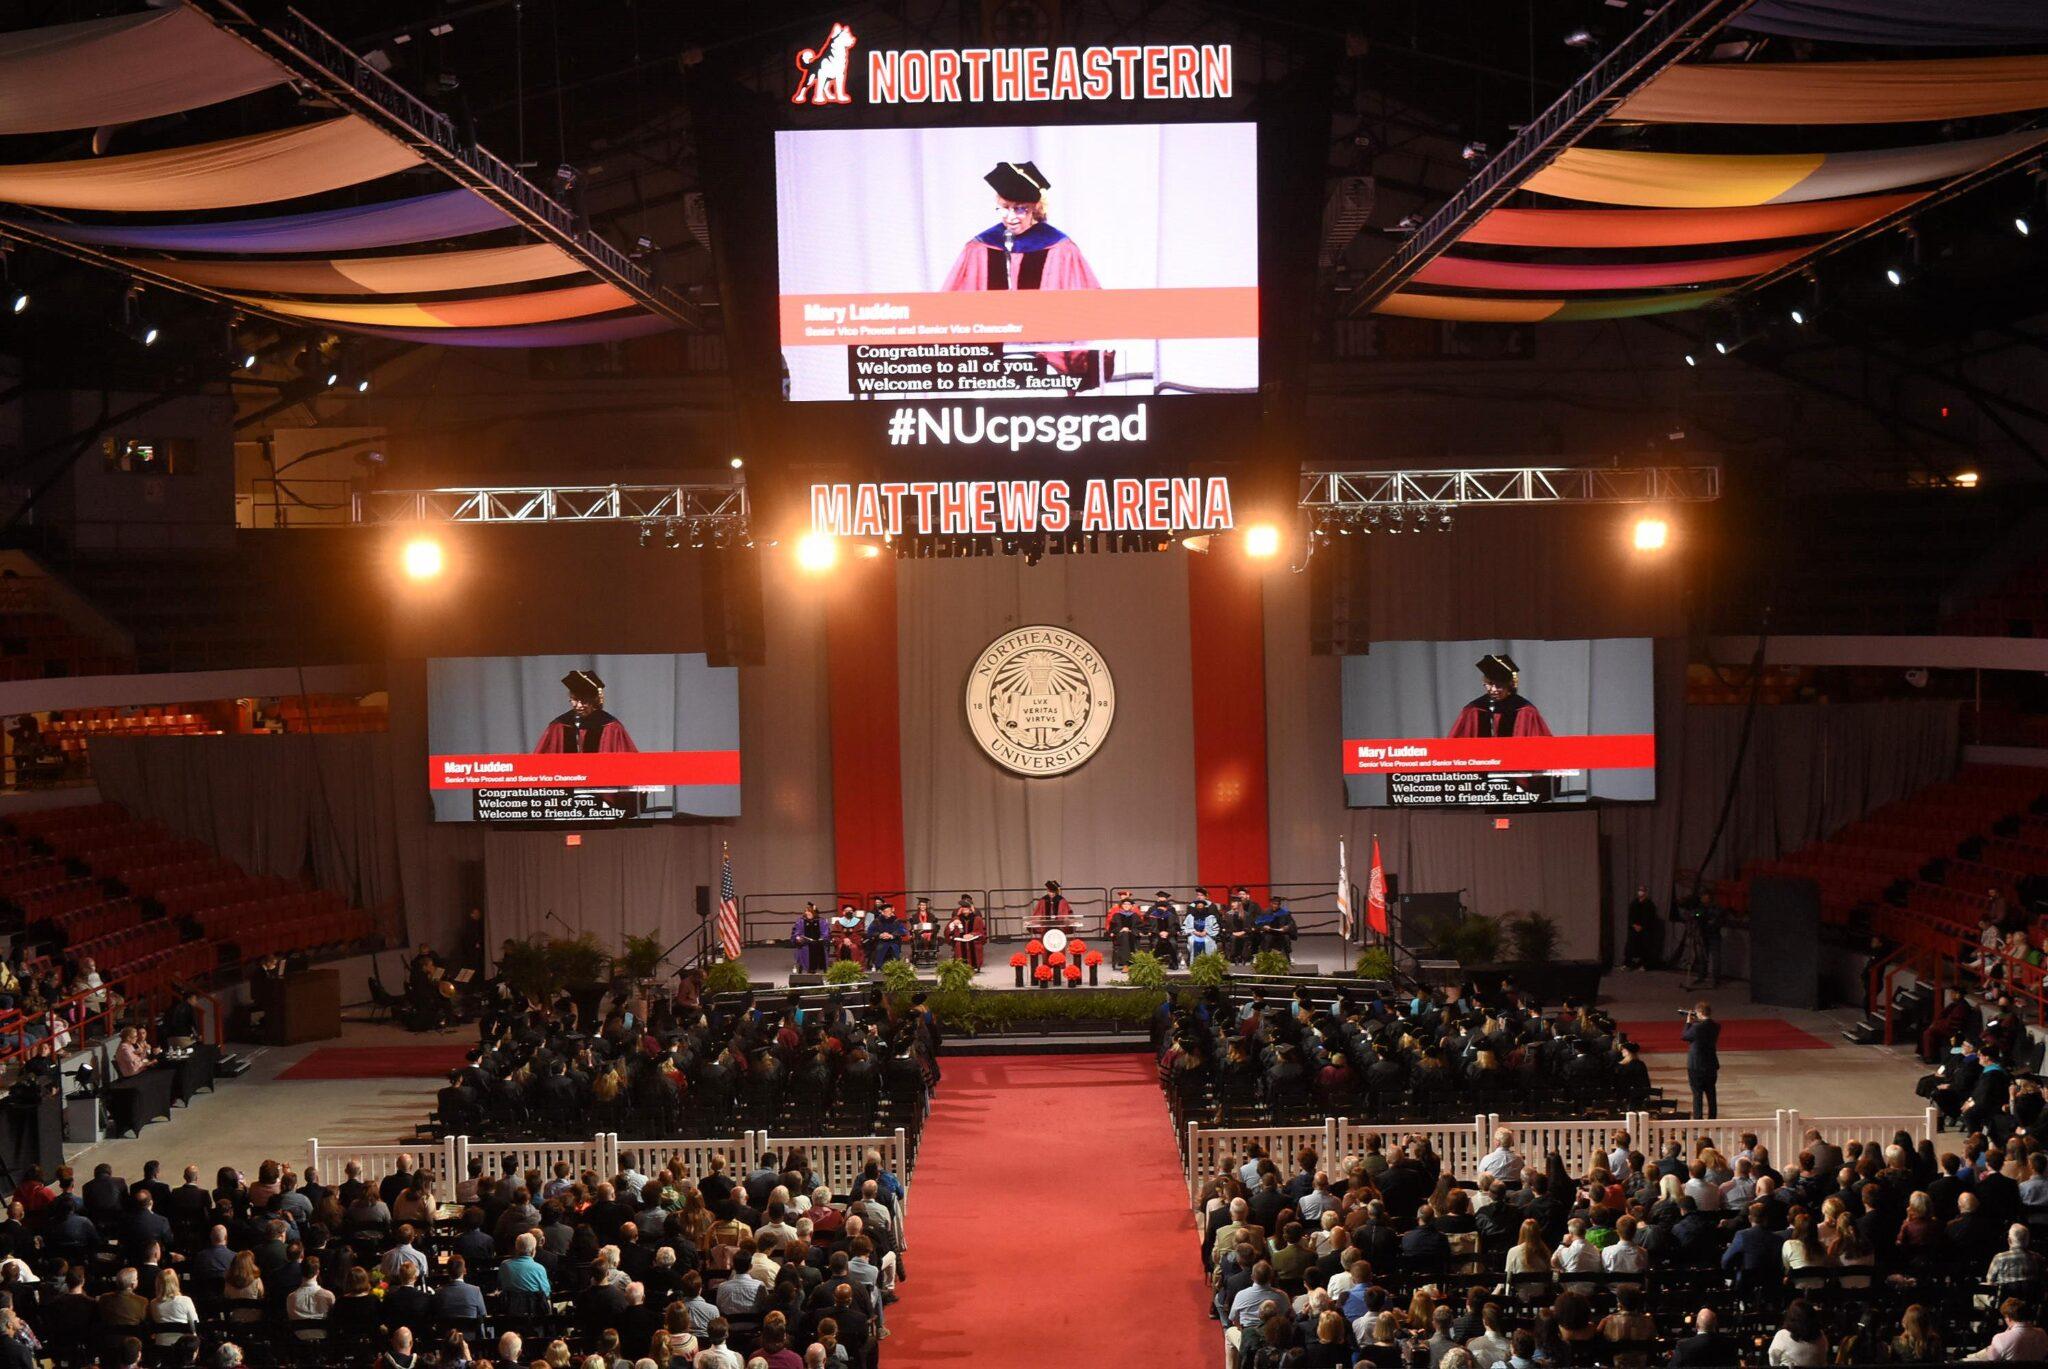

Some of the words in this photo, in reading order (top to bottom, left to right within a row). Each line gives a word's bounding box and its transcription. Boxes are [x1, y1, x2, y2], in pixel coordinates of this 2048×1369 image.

[868, 44, 1233, 104] NORTHEASTERN
[804, 303, 846, 324] Mary
[856, 343, 994, 360] Congratulations.
[857, 361, 932, 375] Welcome
[937, 361, 953, 374] to
[957, 360, 978, 373] all
[983, 360, 1001, 373] of
[1004, 361, 1038, 375] you.
[857, 377, 932, 391] Welcome
[937, 377, 953, 390] to
[958, 376, 1020, 390] friends,
[1026, 375, 1082, 390] faculty
[888, 403, 1147, 452] #NUcpsgrad
[810, 481, 1070, 537] MATTHEWS
[1082, 477, 1235, 531] ARENA
[978, 632, 1102, 677] NORTHEASTERN
[991, 736, 1092, 768] UNIVERSITY
[1358, 747, 1386, 759] Mary
[1388, 746, 1427, 757] Ludden
[445, 762, 472, 775] Mary
[474, 761, 513, 773] Ludden
[1392, 772, 1482, 783] Congratulations.
[479, 788, 568, 798] Congratulations.
[1392, 783, 1441, 792] Welcome
[1444, 783, 1455, 792] to
[1458, 782, 1472, 791] all
[1474, 782, 1486, 791] of
[1488, 783, 1511, 792] you.
[479, 799, 528, 808] Welcome
[531, 799, 541, 807] to
[544, 798, 558, 807] all
[561, 798, 572, 807] of
[574, 799, 597, 808] you.
[1392, 794, 1441, 803] Welcome
[1445, 795, 1455, 803] to
[1458, 793, 1499, 802] friends,
[1503, 792, 1540, 802] faculty
[479, 810, 528, 818] Welcome
[531, 810, 541, 818] to
[545, 808, 585, 818] friends,
[589, 808, 625, 818] faculty
